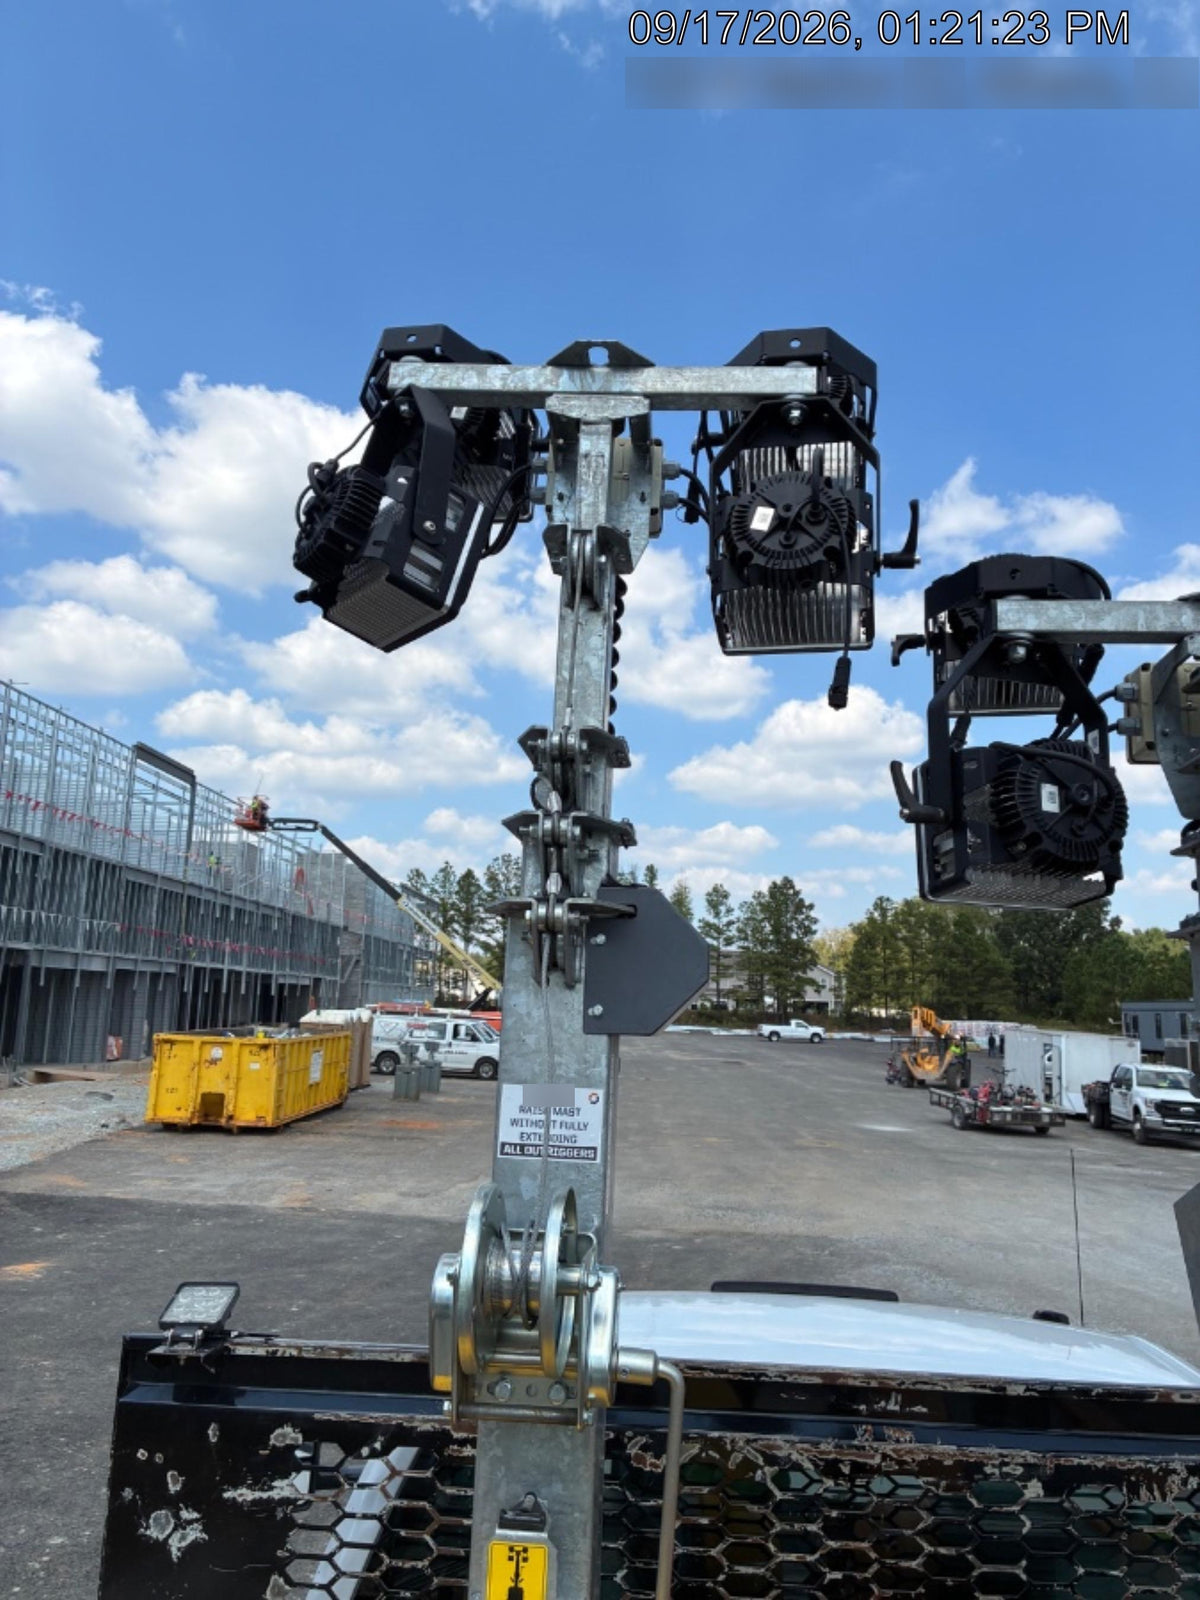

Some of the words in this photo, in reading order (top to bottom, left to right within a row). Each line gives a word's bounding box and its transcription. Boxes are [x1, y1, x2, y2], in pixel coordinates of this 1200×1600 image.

[519, 1105, 548, 1115] RAIS
[552, 1107, 582, 1117] MAST
[510, 1118, 558, 1129] WITHOT
[560, 1120, 589, 1131] FULLY
[503, 1144, 522, 1155] ALL
